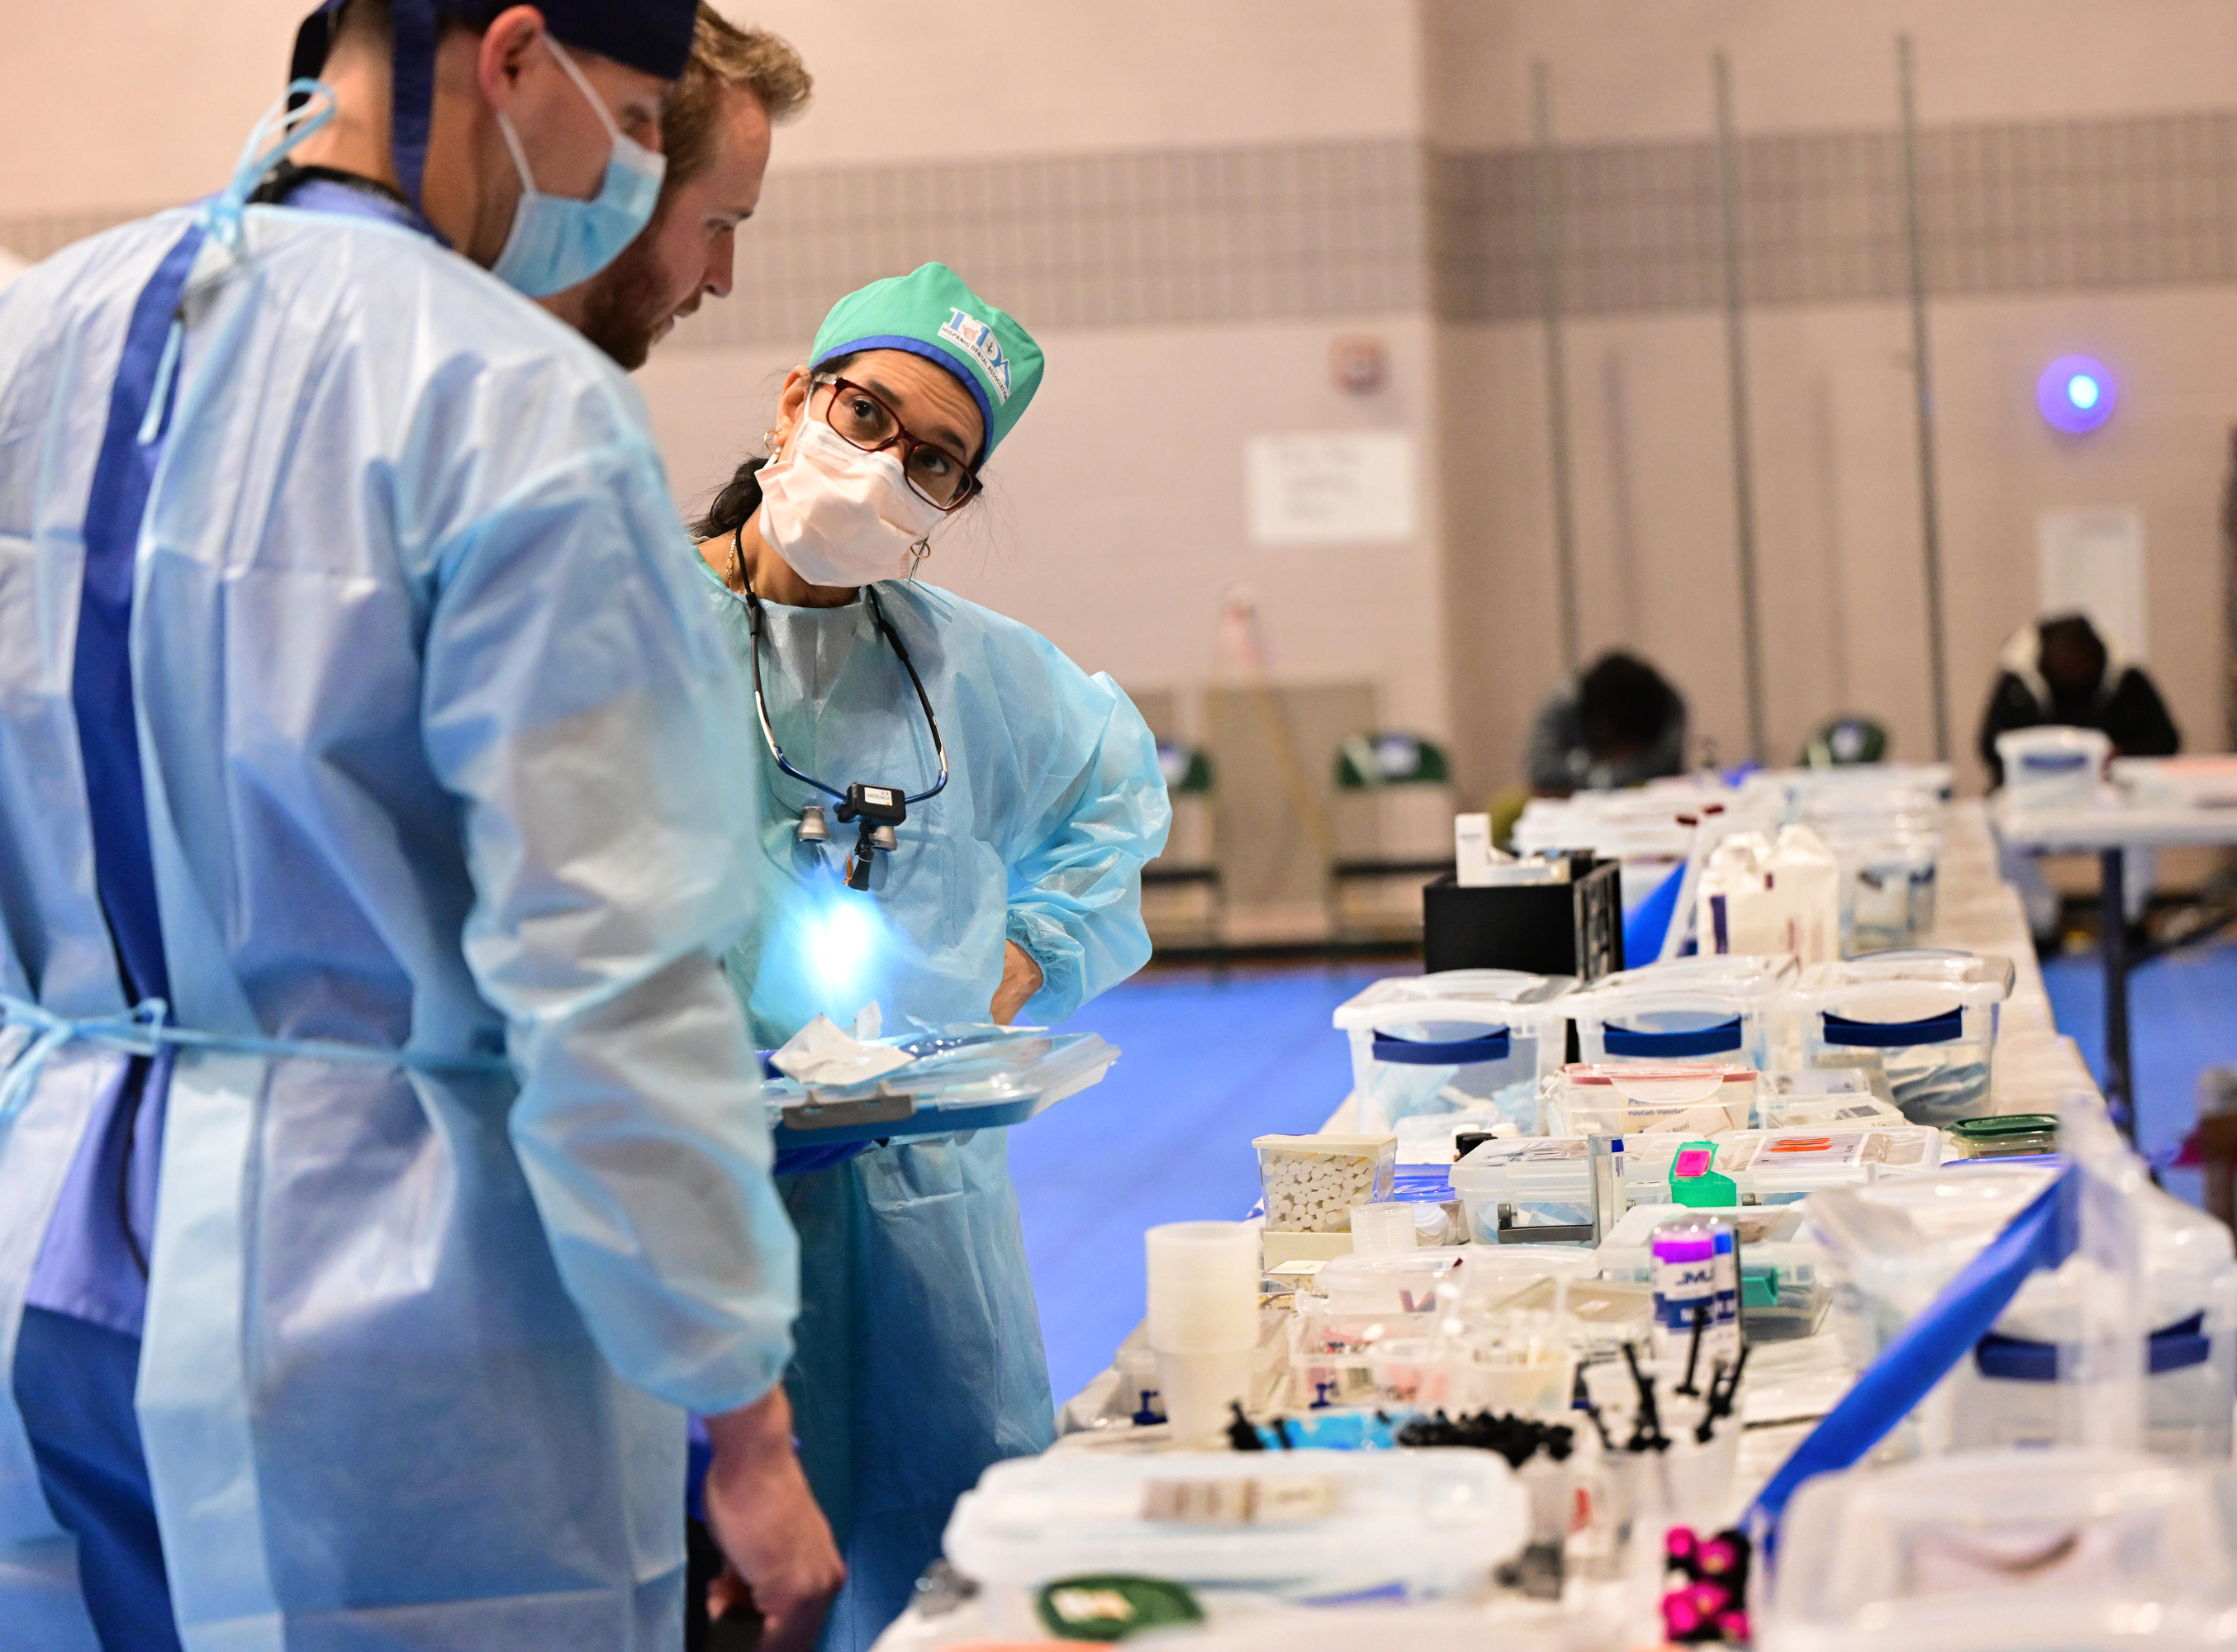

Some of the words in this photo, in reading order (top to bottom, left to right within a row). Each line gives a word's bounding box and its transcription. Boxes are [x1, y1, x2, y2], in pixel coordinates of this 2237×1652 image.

[942, 326, 971, 347] HISPANIC
[971, 344, 988, 368] DENTAL
[987, 366, 1008, 401] ASSOCIATION
